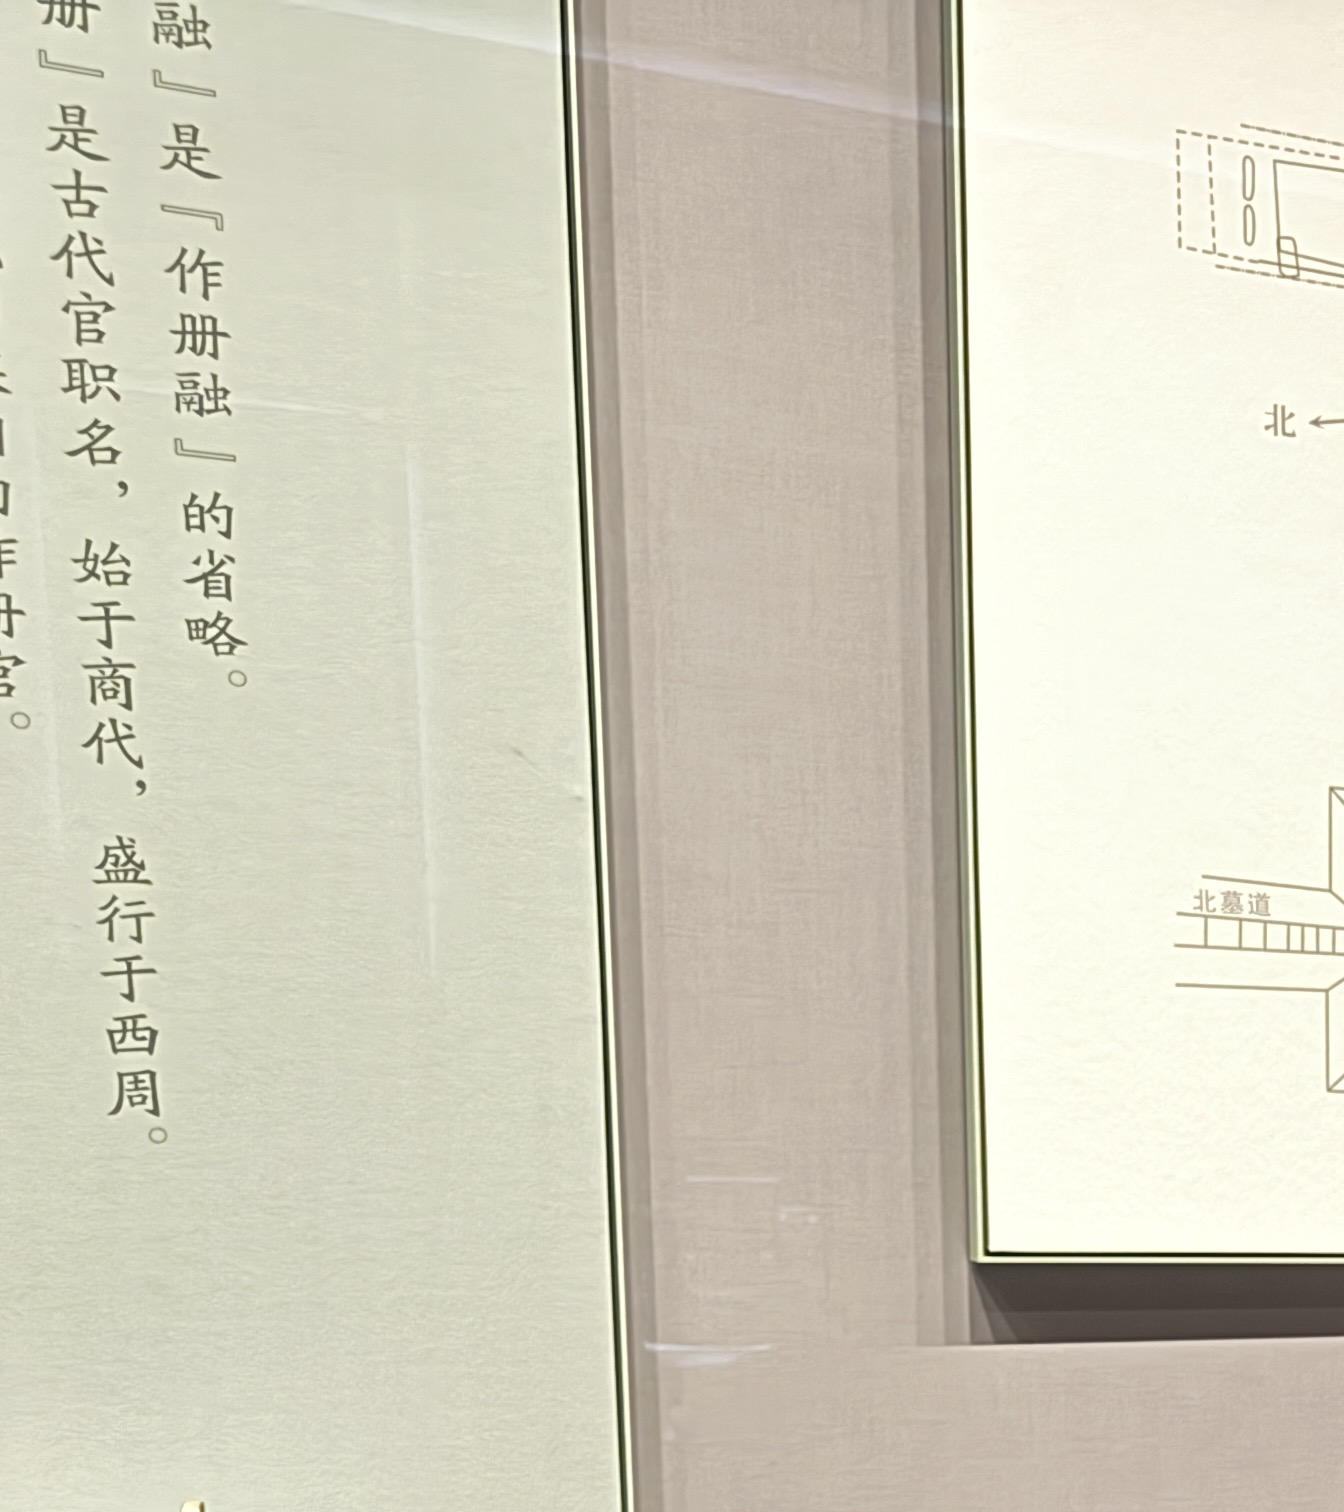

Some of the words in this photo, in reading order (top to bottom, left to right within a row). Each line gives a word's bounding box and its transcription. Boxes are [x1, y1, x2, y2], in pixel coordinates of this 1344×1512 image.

[1263, 403, 1297, 438] 北
[1193, 888, 1272, 917] 北墓道
